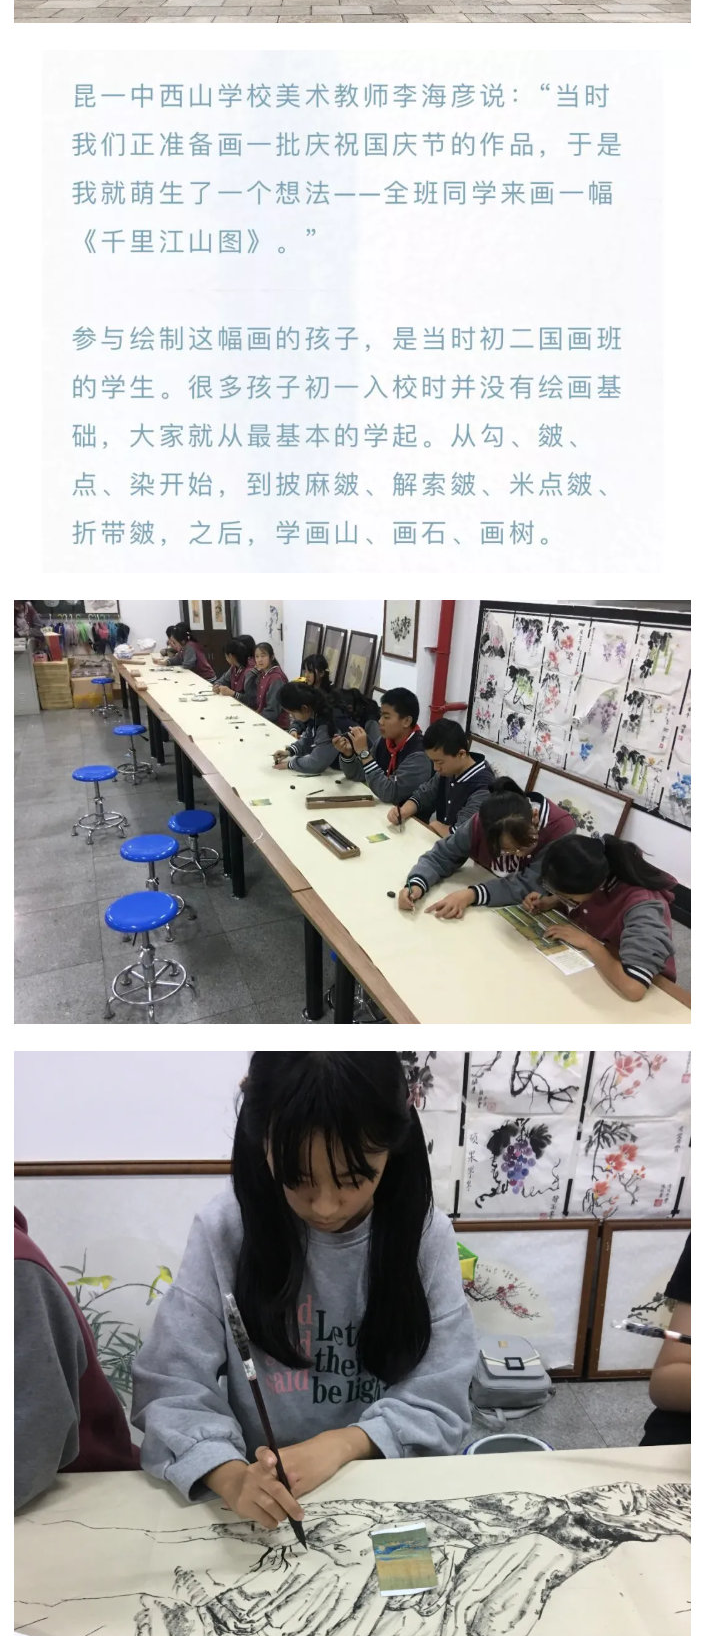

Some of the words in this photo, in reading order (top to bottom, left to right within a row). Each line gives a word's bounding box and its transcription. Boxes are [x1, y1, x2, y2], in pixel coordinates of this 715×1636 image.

[80, 228, 317, 254] 《千里江山图》。”
[313, 1376, 342, 1404] be
